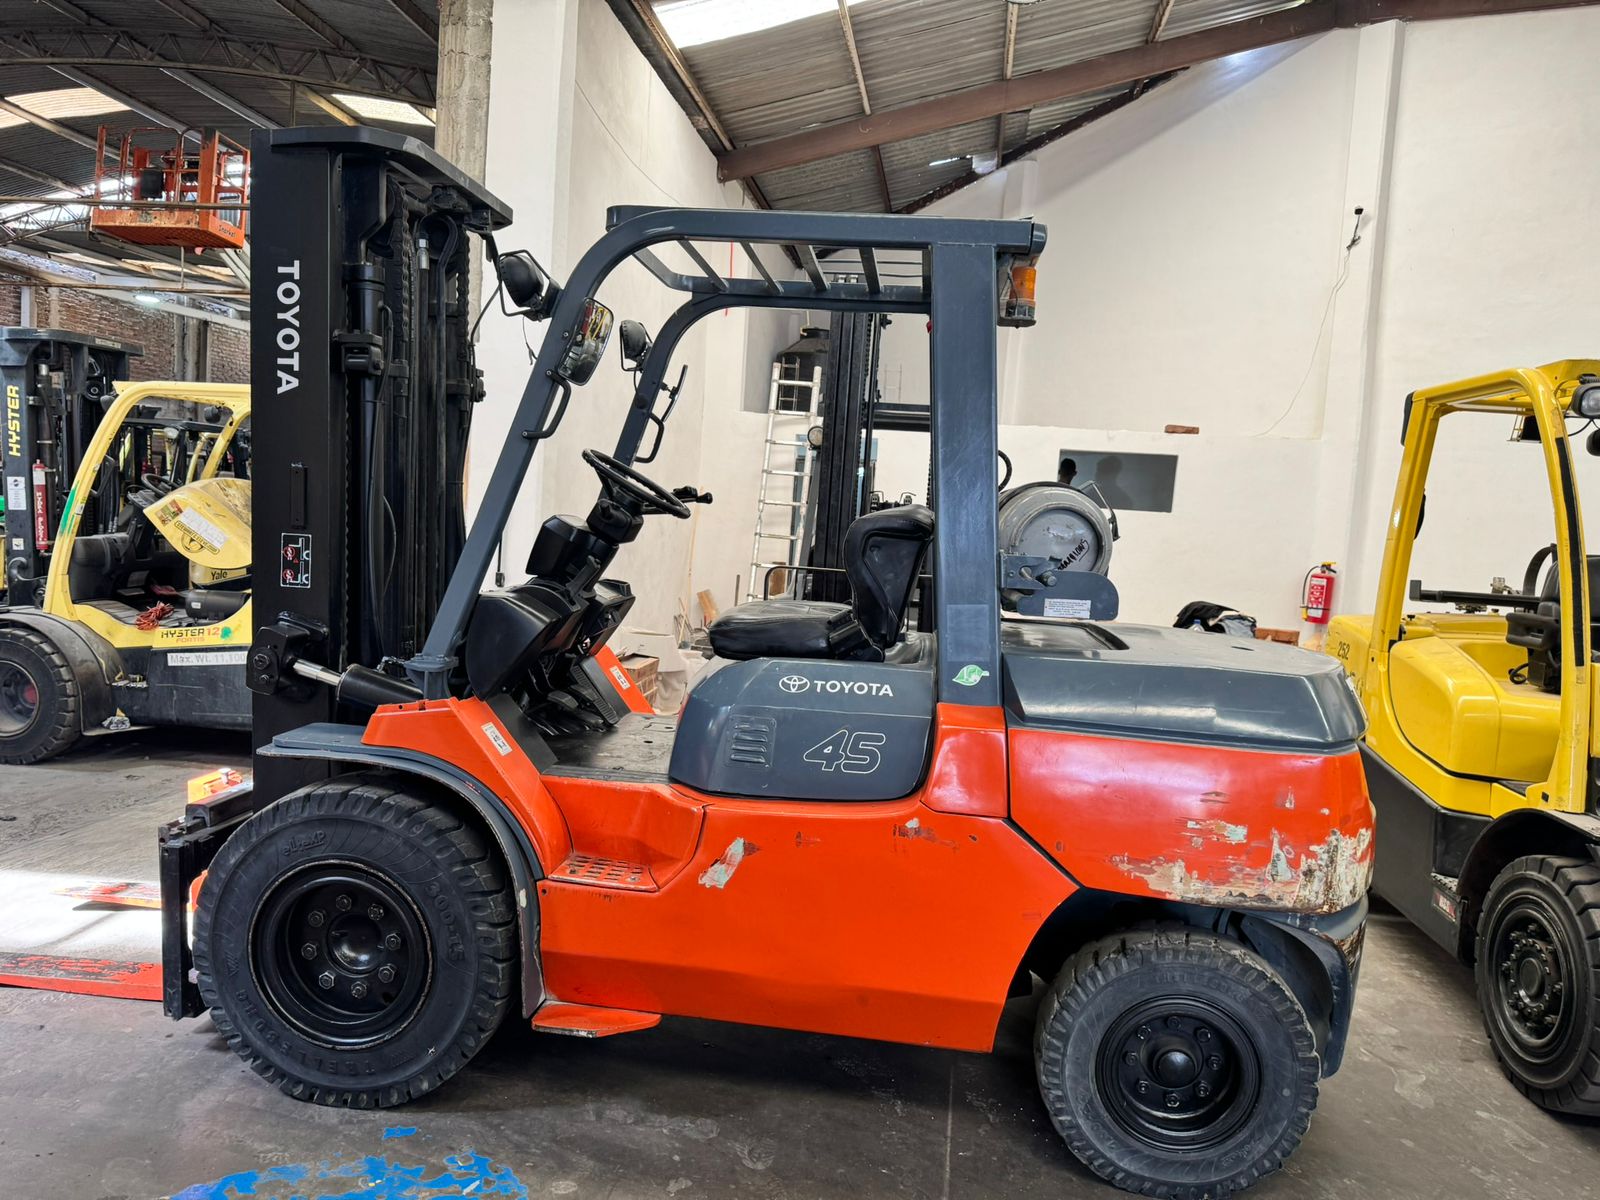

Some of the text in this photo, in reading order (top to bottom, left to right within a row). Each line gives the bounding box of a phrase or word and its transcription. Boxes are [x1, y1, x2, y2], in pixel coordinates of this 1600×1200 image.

[276, 259, 301, 395] TOYOTA
[7, 384, 21, 457] HYSTER
[211, 570, 228, 580] Yale
[161, 628, 205, 639] HYSTER
[170, 654, 194, 664] Max.
[1337, 641, 1350, 660] 252
[814, 679, 894, 697] TOYOTA
[803, 729, 886, 774] 45
